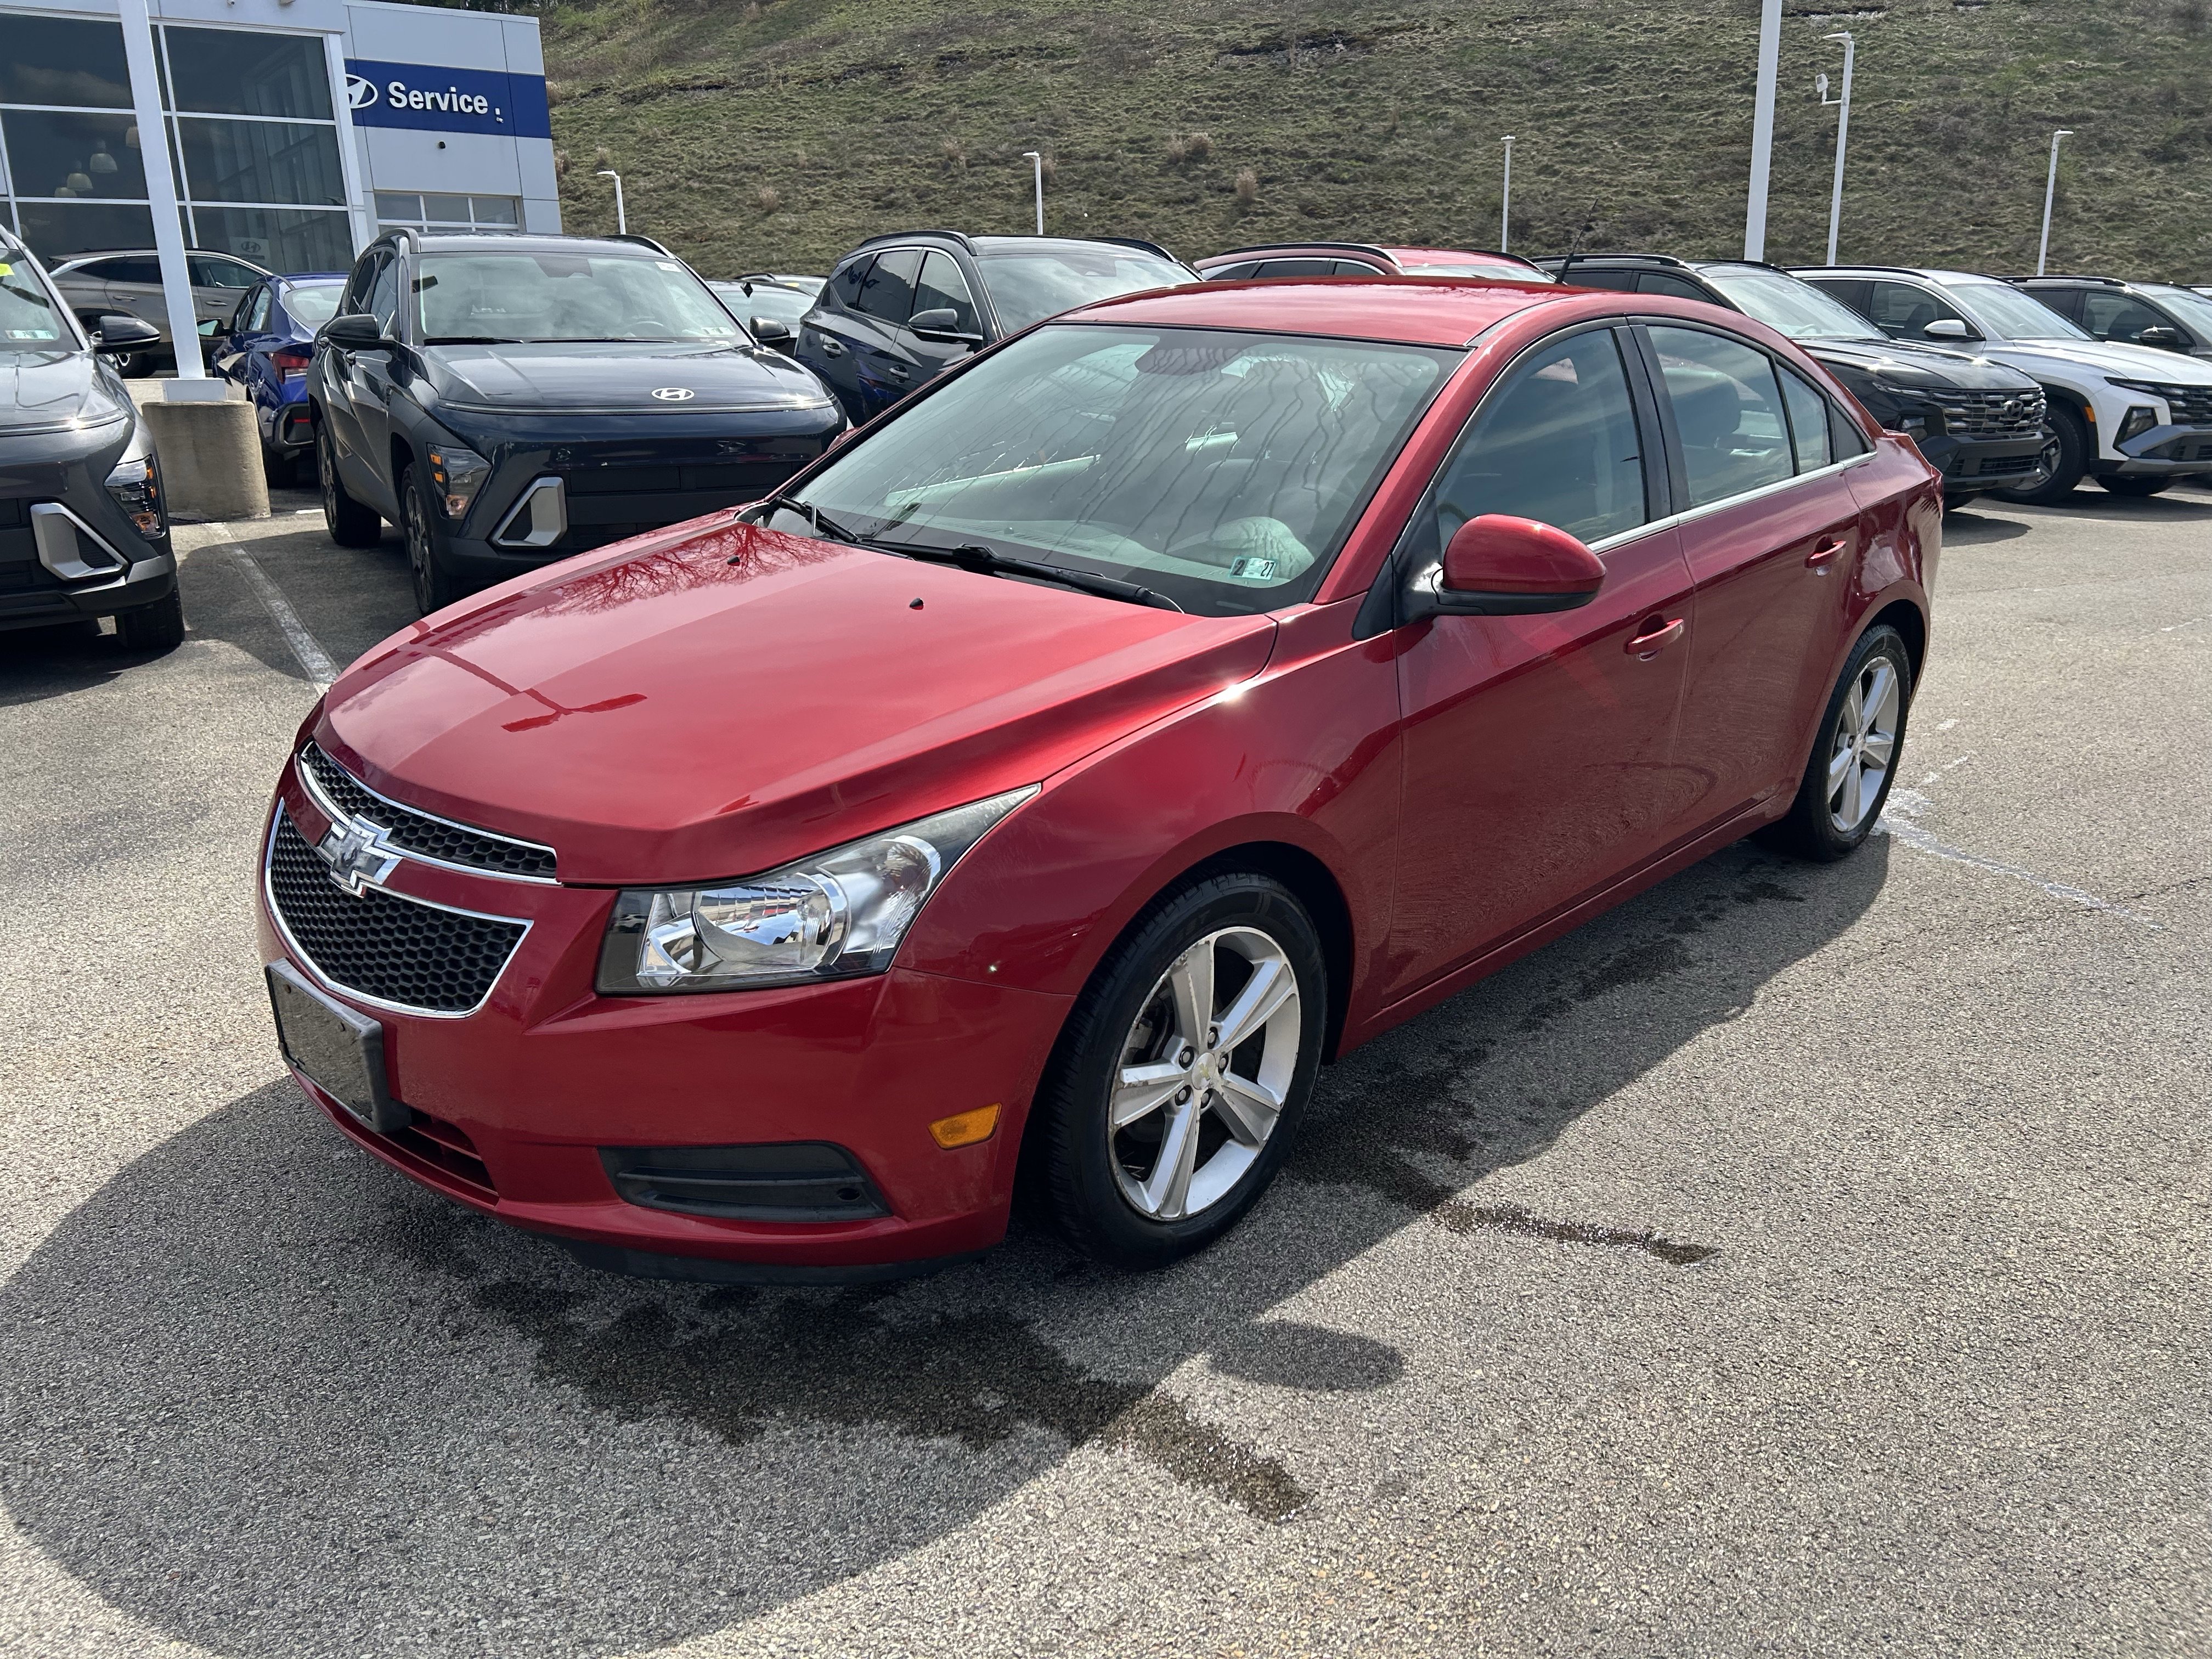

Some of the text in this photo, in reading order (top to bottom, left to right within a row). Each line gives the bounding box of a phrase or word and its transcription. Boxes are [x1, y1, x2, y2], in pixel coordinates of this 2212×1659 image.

[388, 82, 488, 114] Service
[1233, 560, 1274, 577] 2 27
